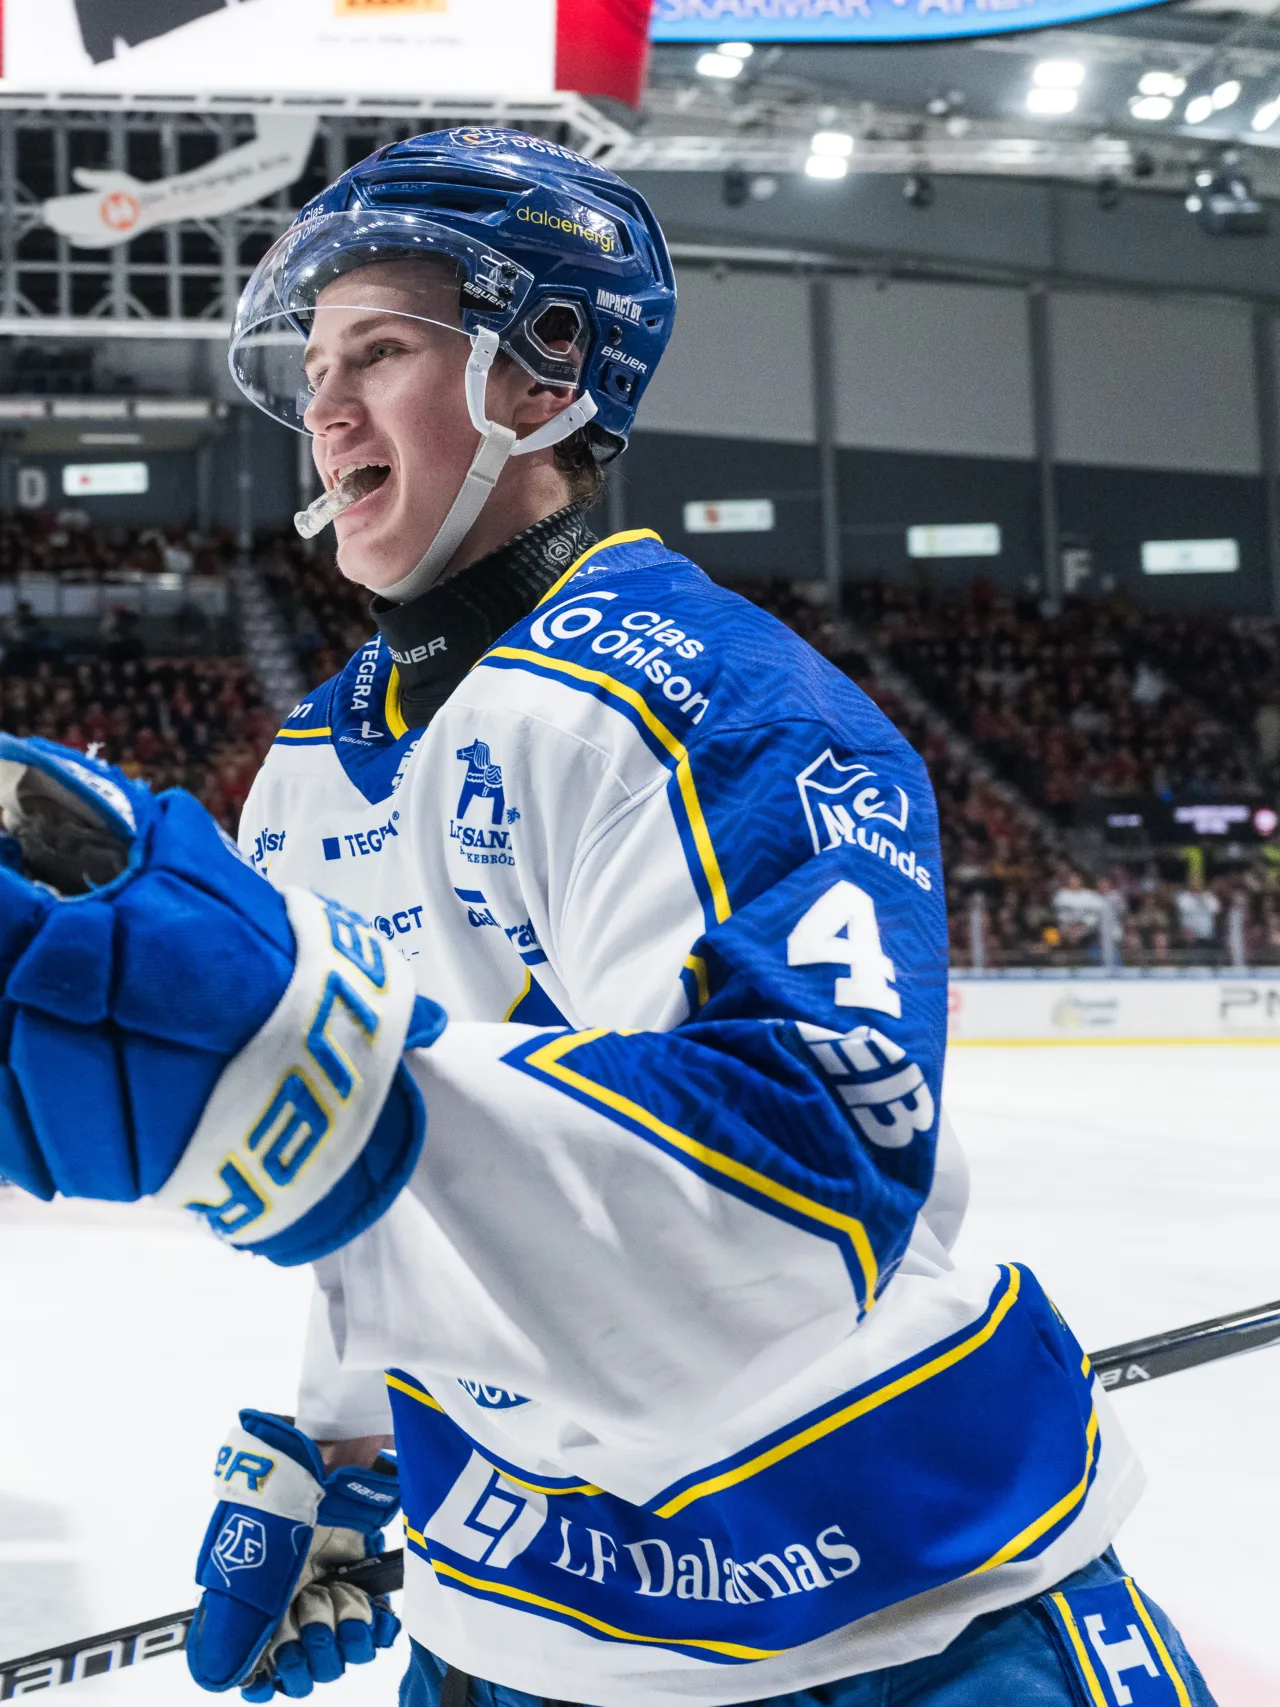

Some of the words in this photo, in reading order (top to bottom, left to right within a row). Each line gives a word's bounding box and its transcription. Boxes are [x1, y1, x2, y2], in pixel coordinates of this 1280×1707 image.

[516, 206, 616, 252] dalaenergi
[596, 288, 632, 316] IMPACT
[630, 302, 642, 321] BY
[350, 635, 382, 710] TEGERA
[621, 611, 704, 659] Clas
[591, 630, 710, 725] Ohlson
[787, 880, 901, 1018] 4
[550, 1516, 619, 1584] LF
[623, 1524, 862, 1606] Dalarnas
